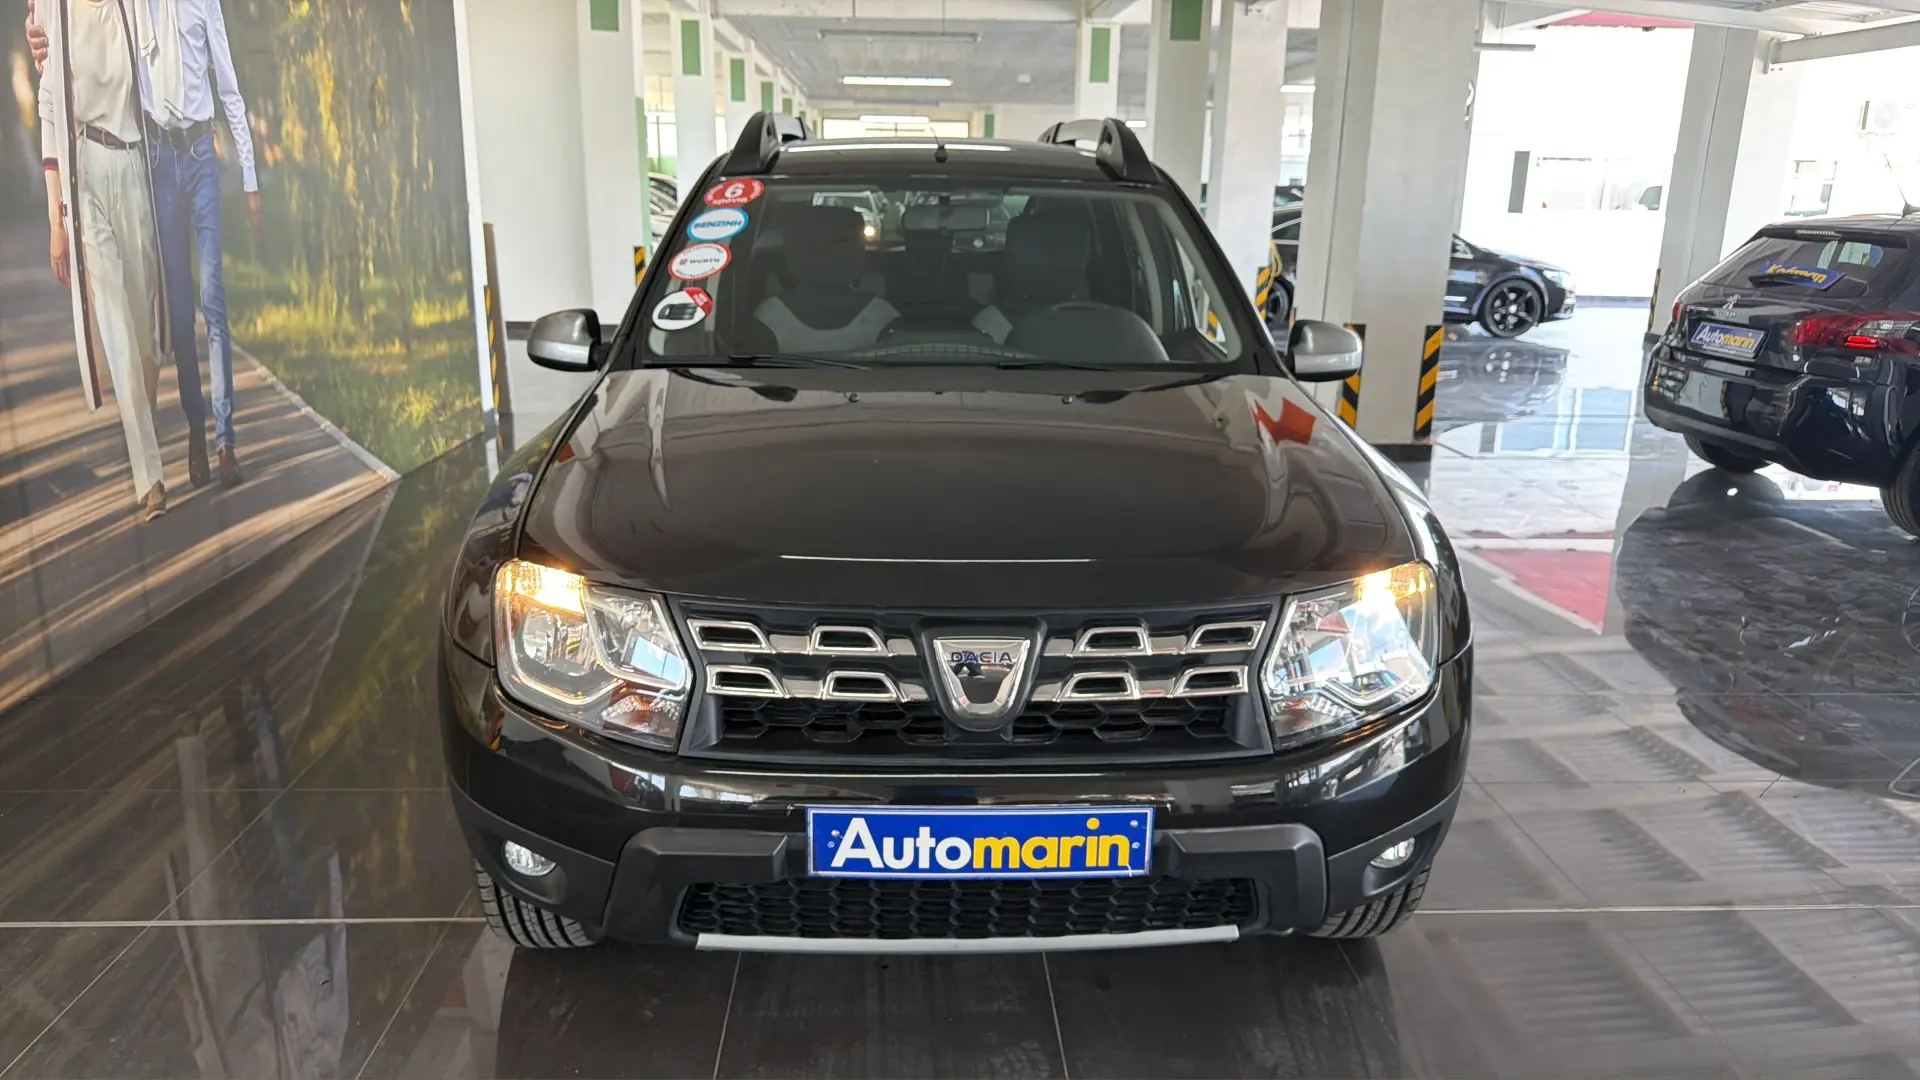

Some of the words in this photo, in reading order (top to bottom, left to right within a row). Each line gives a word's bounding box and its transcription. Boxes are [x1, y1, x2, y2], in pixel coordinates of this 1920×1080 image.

[724, 182, 745, 199] 6
[1696, 325, 1755, 348] Automarin
[951, 651, 1013, 663] DACIA
[831, 817, 1129, 869] Automarin
